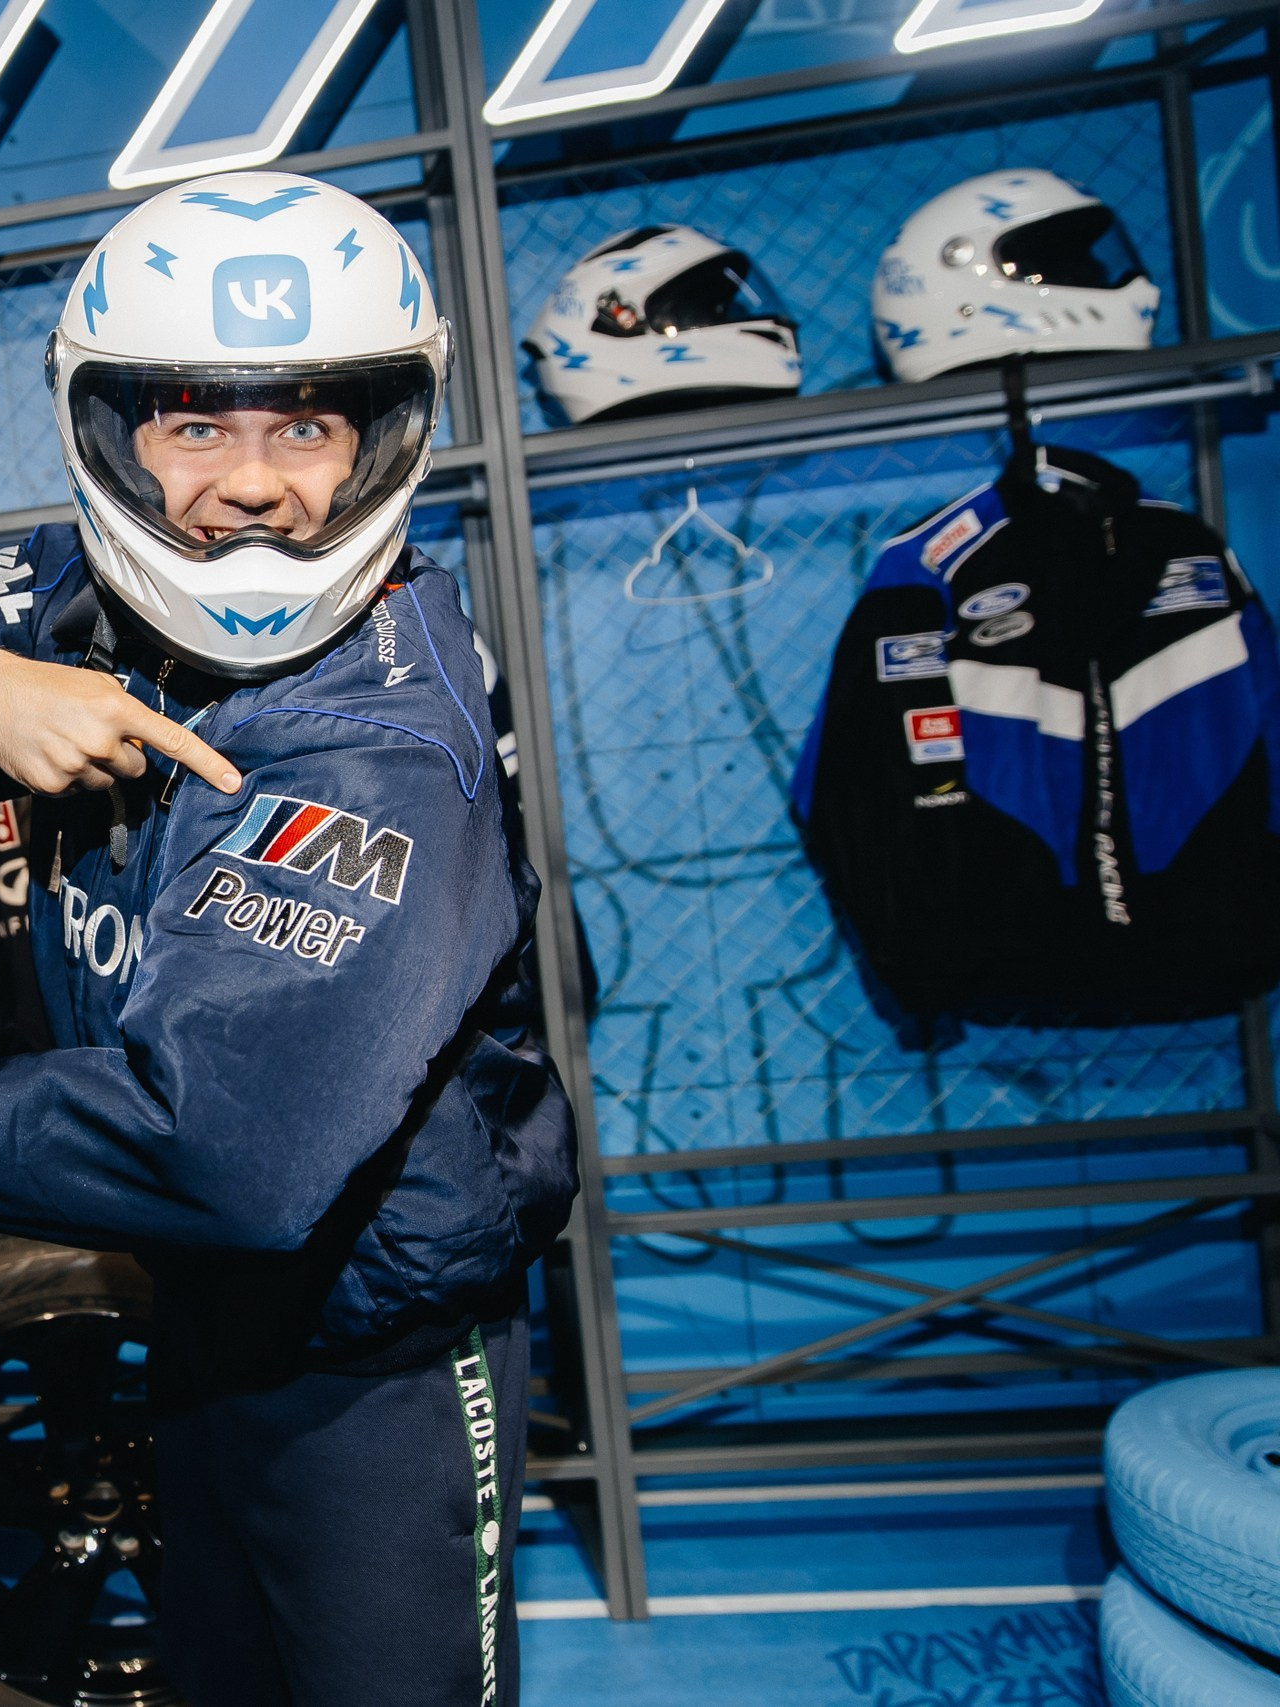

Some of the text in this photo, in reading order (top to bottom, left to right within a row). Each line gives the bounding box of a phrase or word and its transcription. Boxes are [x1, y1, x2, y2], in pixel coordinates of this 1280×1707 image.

[227, 278, 296, 320] VK
[375, 619, 397, 666] SUISSE
[282, 812, 414, 905] M
[184, 867, 365, 968] Power
[455, 1354, 497, 1504] LACOSTE
[480, 1568, 499, 1707] LACOSTE
